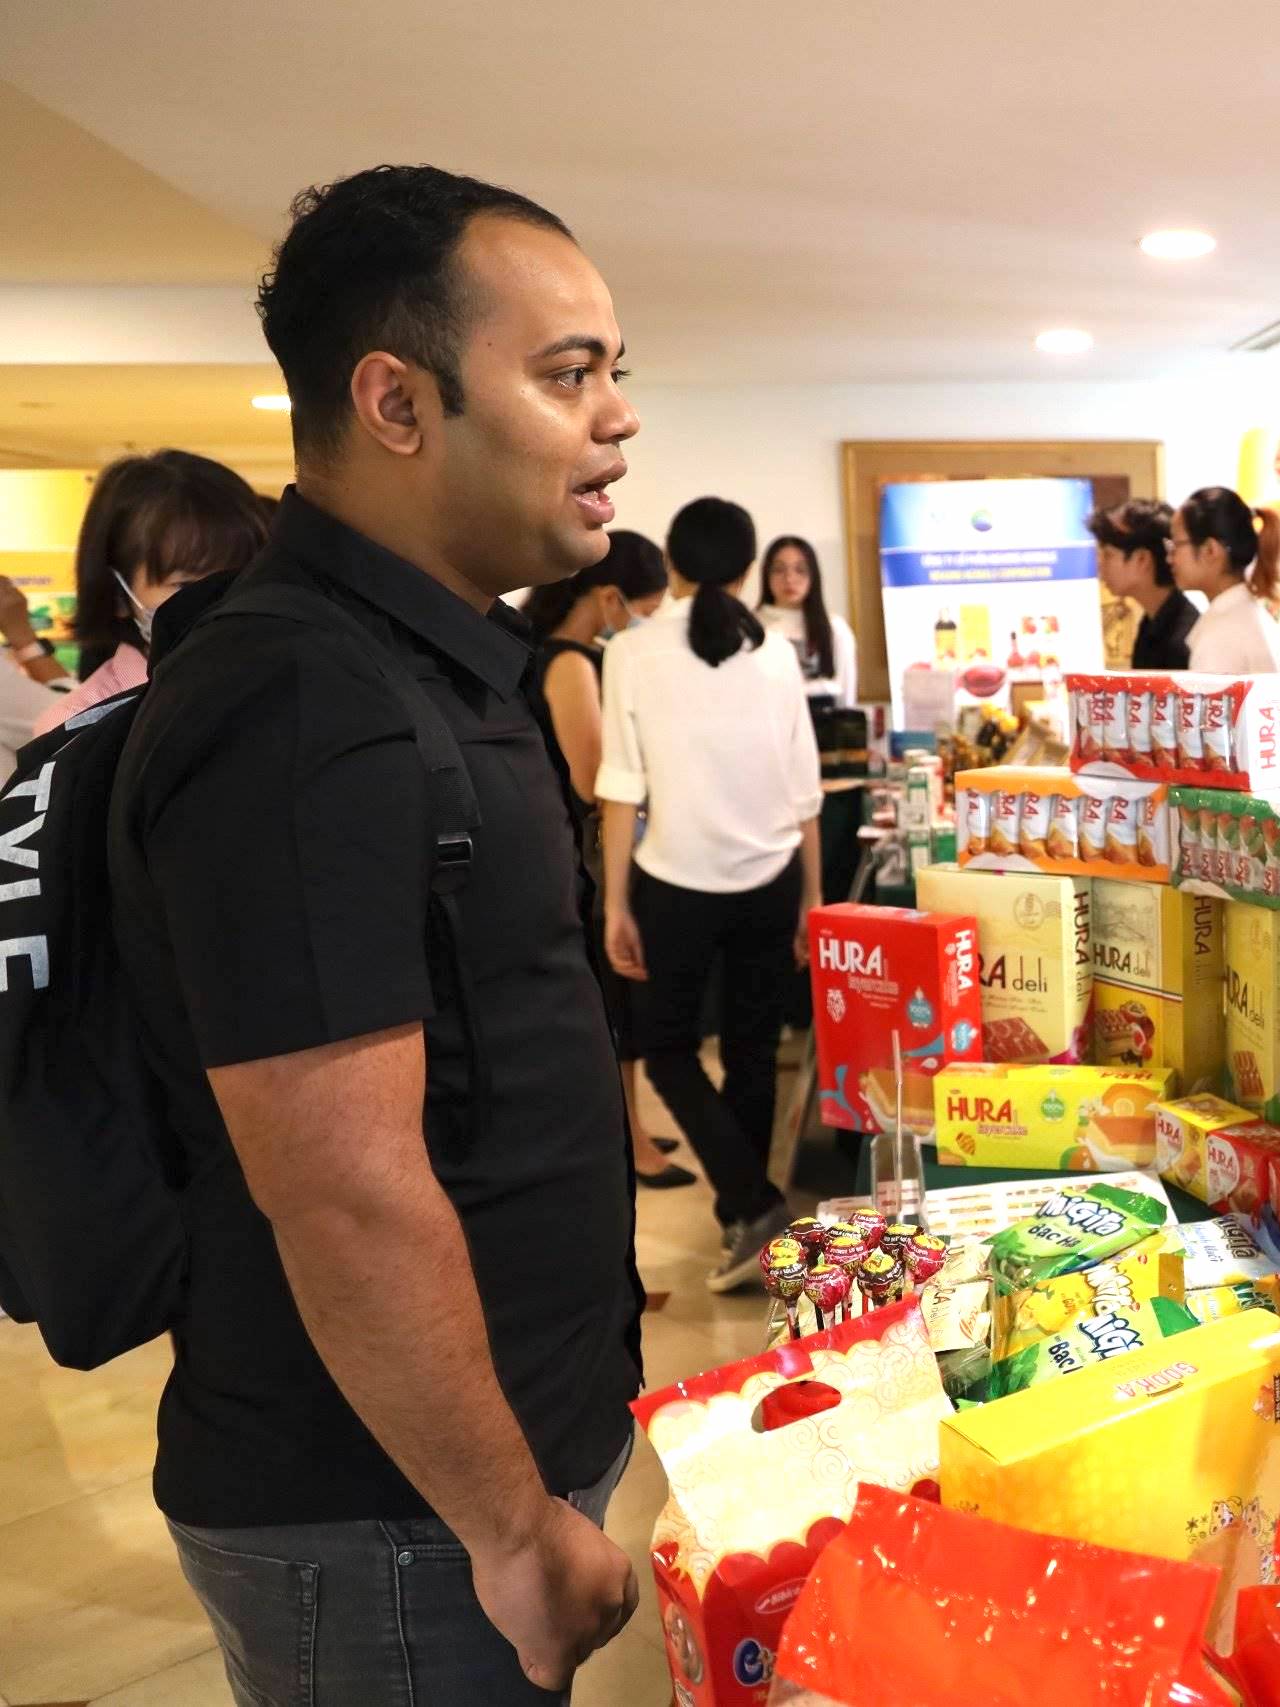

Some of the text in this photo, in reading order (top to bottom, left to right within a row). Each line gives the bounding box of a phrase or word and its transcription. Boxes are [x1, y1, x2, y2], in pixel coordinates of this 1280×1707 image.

[1258, 705, 1276, 770] HURA
[1073, 891, 1090, 966] HURA
[1194, 895, 1212, 955] HURA
[819, 936, 882, 977] HURA
[955, 929, 974, 991] HURA
[1012, 955, 1048, 993] deli
[1093, 941, 1131, 973] HURA
[946, 1096, 1013, 1123] HURA
